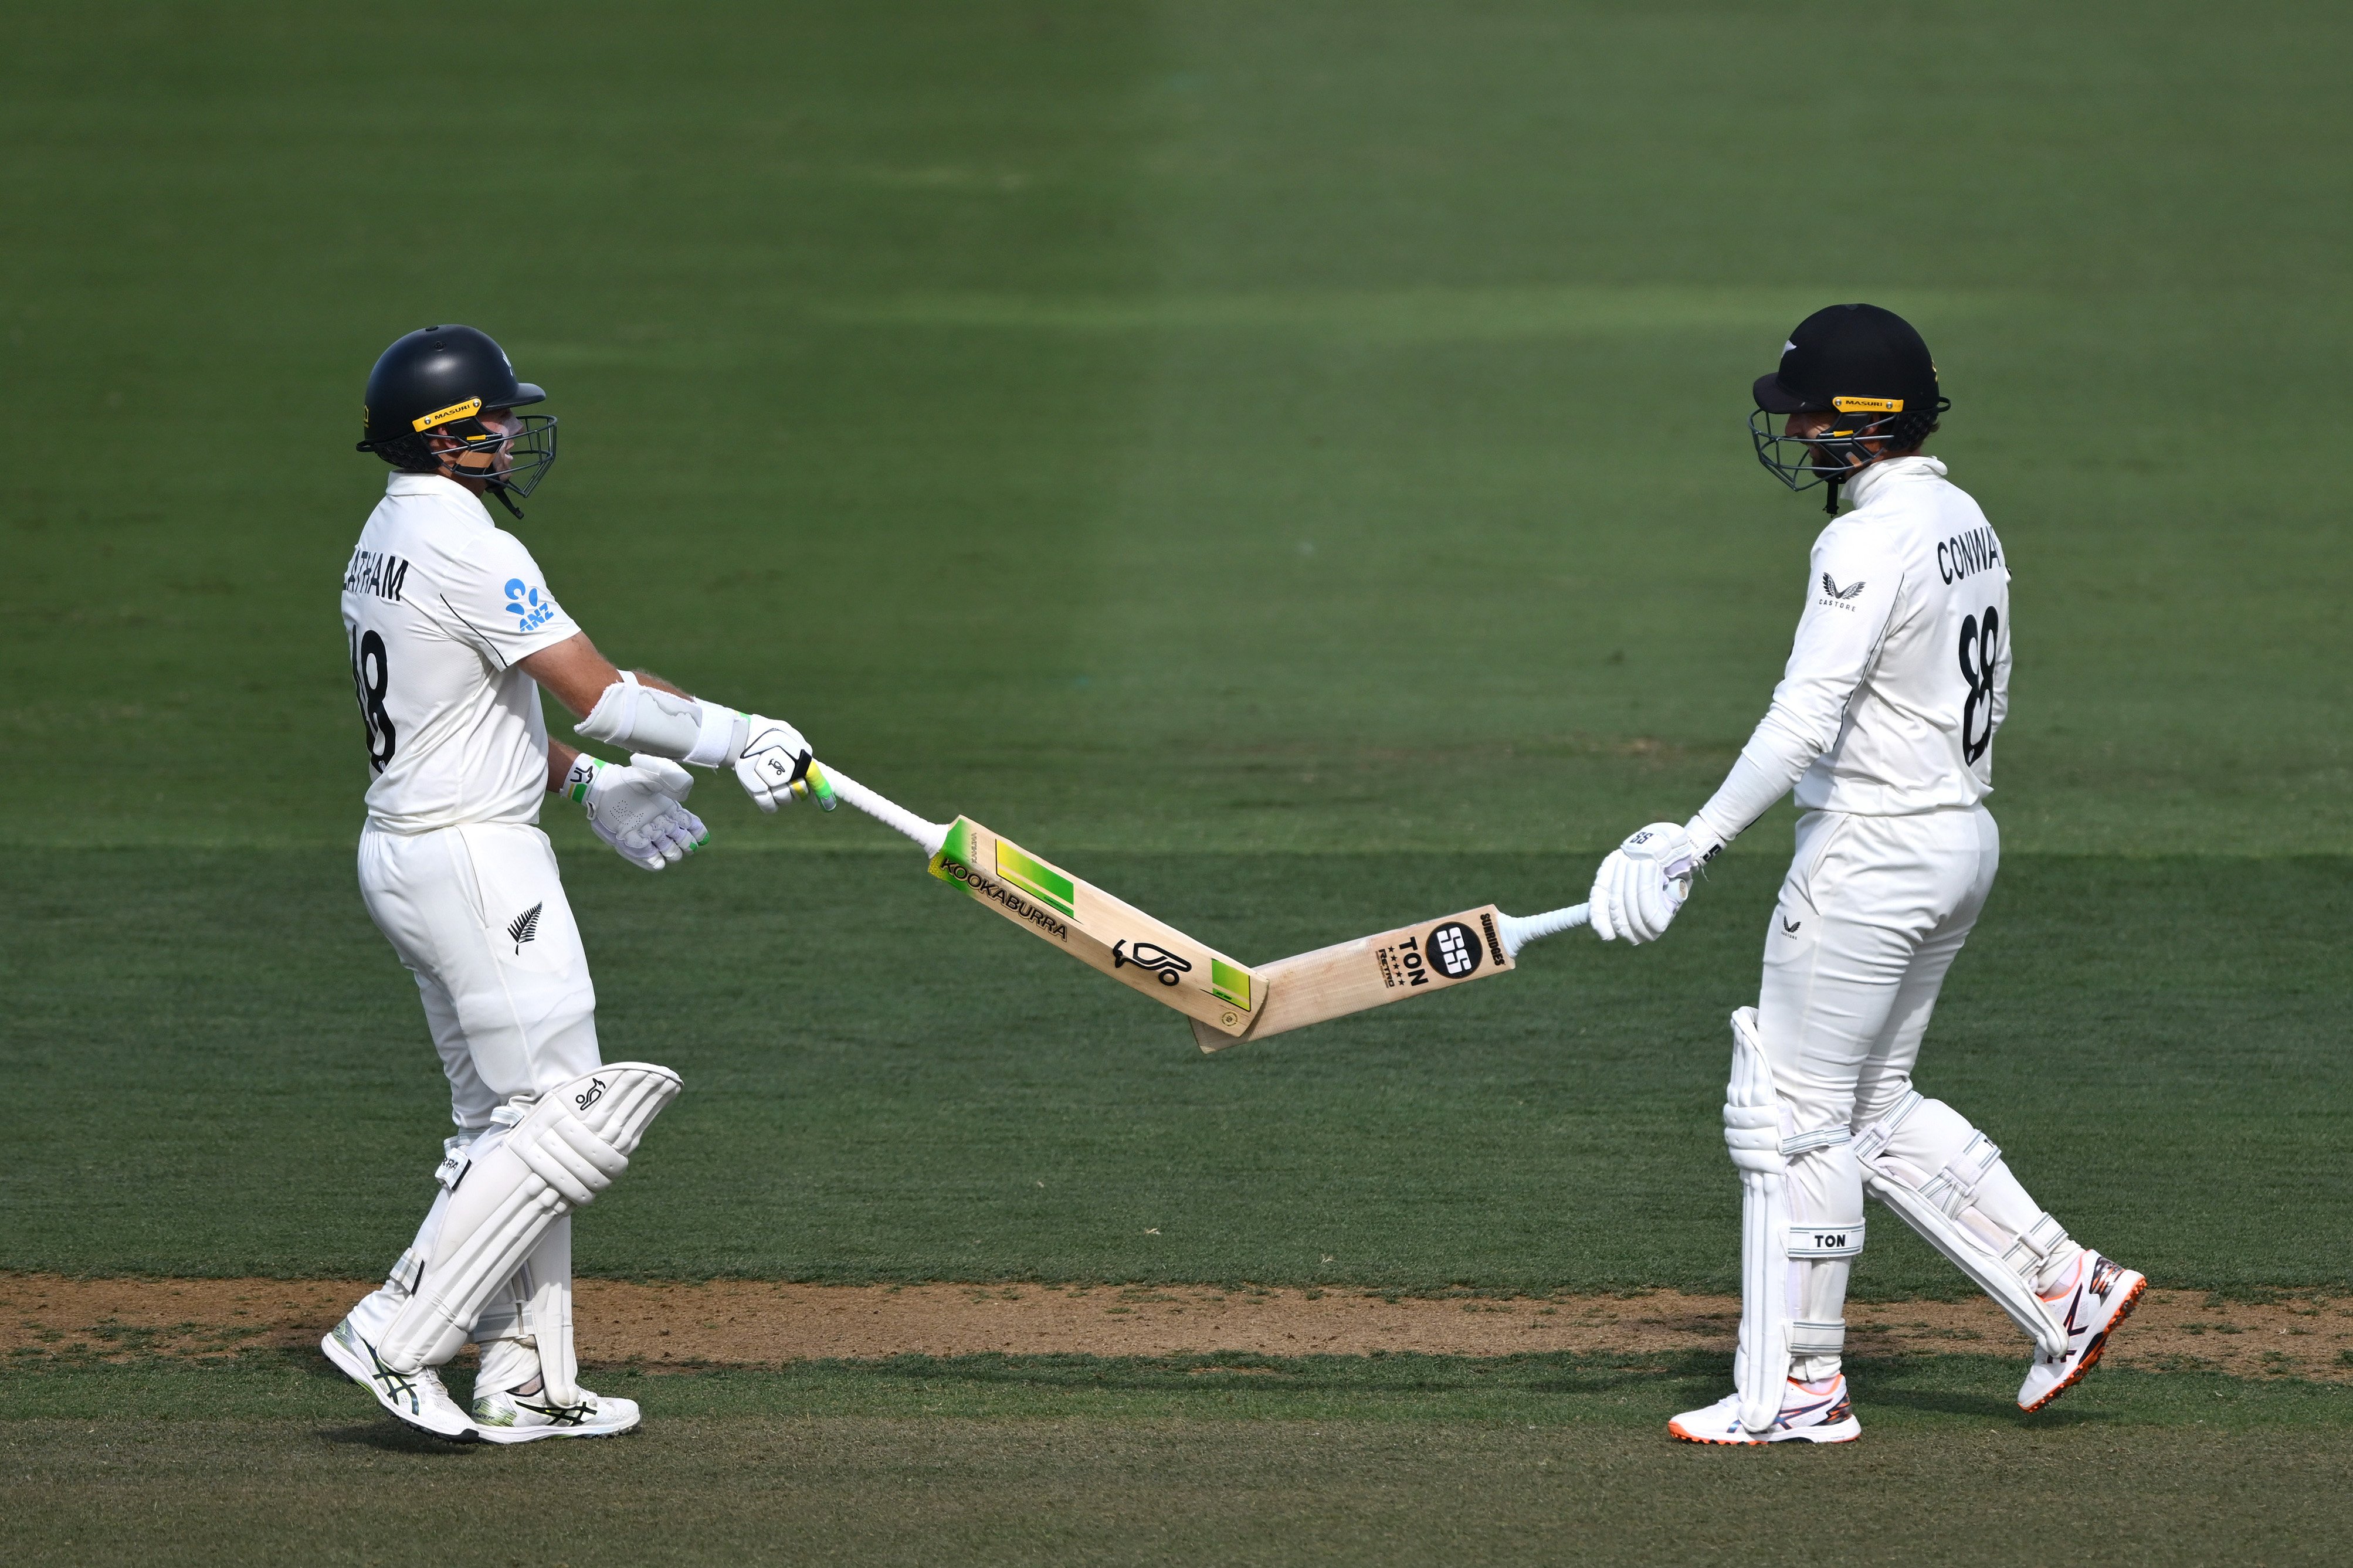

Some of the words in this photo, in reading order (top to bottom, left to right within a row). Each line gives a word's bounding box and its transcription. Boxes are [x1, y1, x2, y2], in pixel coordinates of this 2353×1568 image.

[435, 405, 470, 419] MASURI
[1938, 526, 2002, 585] CONWA
[520, 602, 554, 632] ANZ
[1819, 599, 1856, 612] CASTORE
[1959, 606, 1999, 767] 88
[1630, 831, 1654, 844] SS
[940, 856, 1067, 942] KOOKABURRA
[1437, 926, 1472, 974] SS
[1480, 912, 1506, 966] SUNRIDGES
[1378, 949, 1395, 987] RETRO
[1399, 936, 1429, 986] TON
[1815, 1234, 1846, 1247] TON
